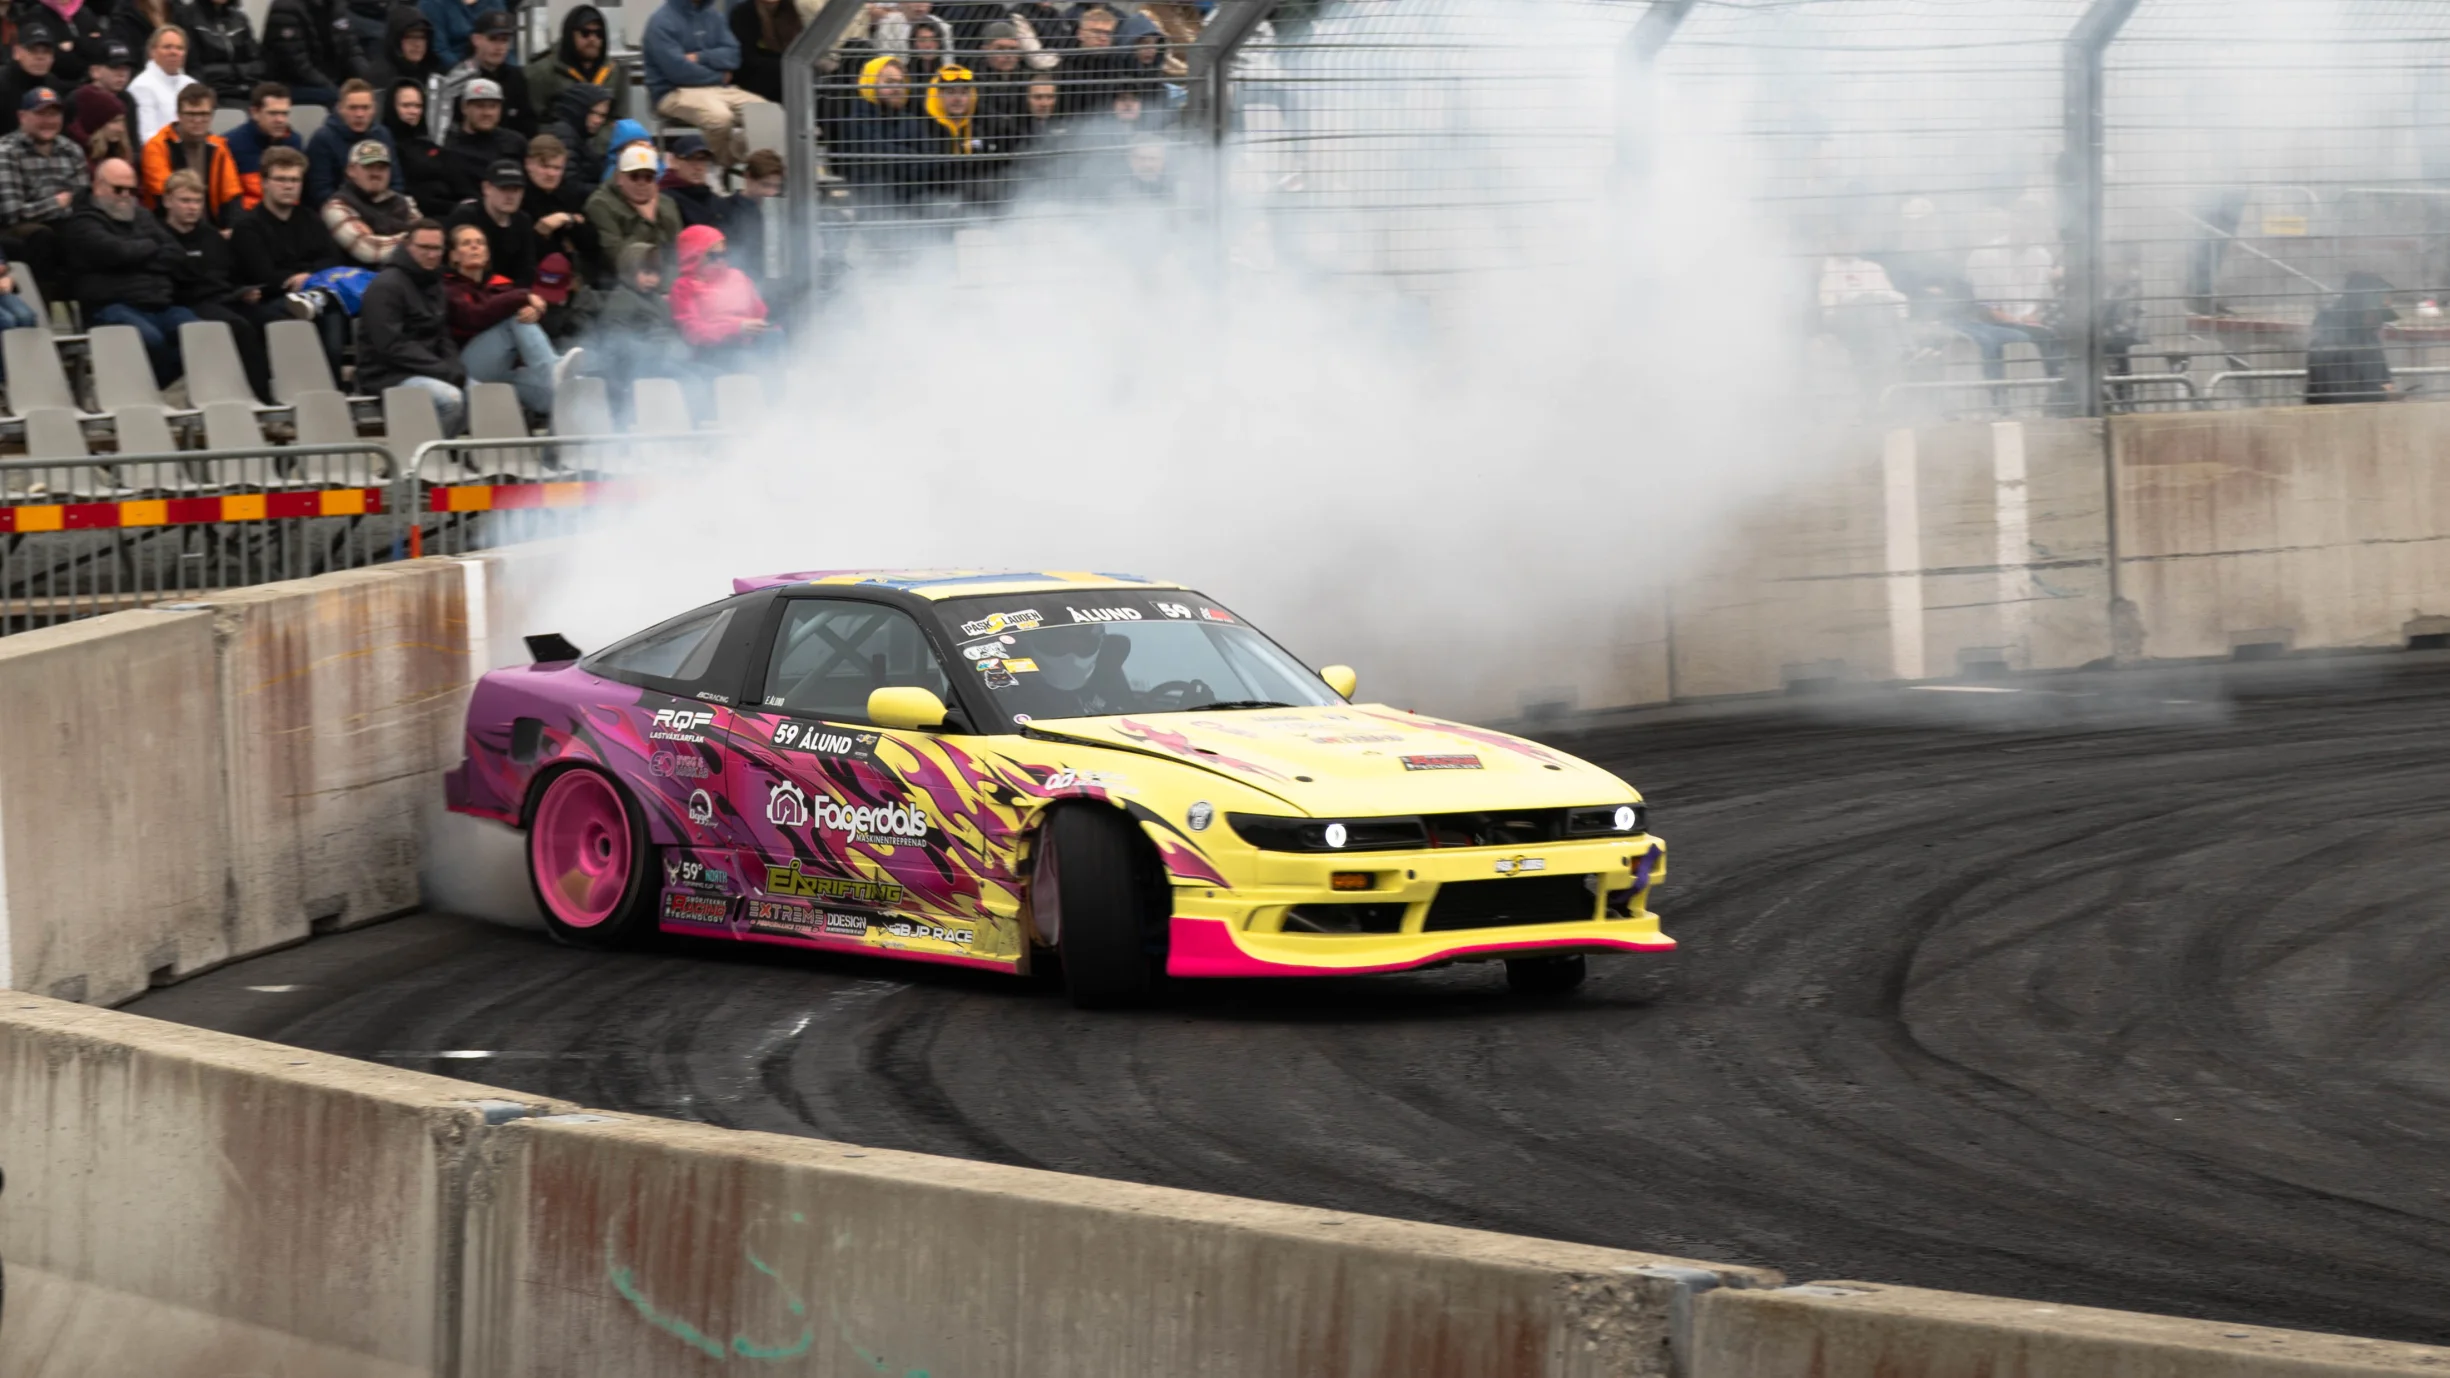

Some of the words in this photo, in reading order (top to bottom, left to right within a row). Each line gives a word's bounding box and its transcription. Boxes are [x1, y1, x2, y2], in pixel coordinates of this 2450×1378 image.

[1066, 606, 1142, 623] ÅLUND
[1157, 603, 1192, 619] 59
[652, 709, 714, 732] RQF
[649, 731, 705, 744] LASTVÄXLARFLAK
[774, 723, 799, 745] 59
[798, 726, 852, 754] ÅLUND
[815, 795, 927, 844] Fagerdals
[856, 834, 927, 848] MASKINENTREPRENAD
[705, 869, 728, 883] NORTH
[671, 895, 727, 918] RACING
[749, 901, 824, 926] EXTREME
[671, 910, 724, 924] TECHNOLOGY
[827, 912, 867, 930] DDESIGN
[900, 923, 931, 938] BJP
[932, 927, 973, 944] RACE
